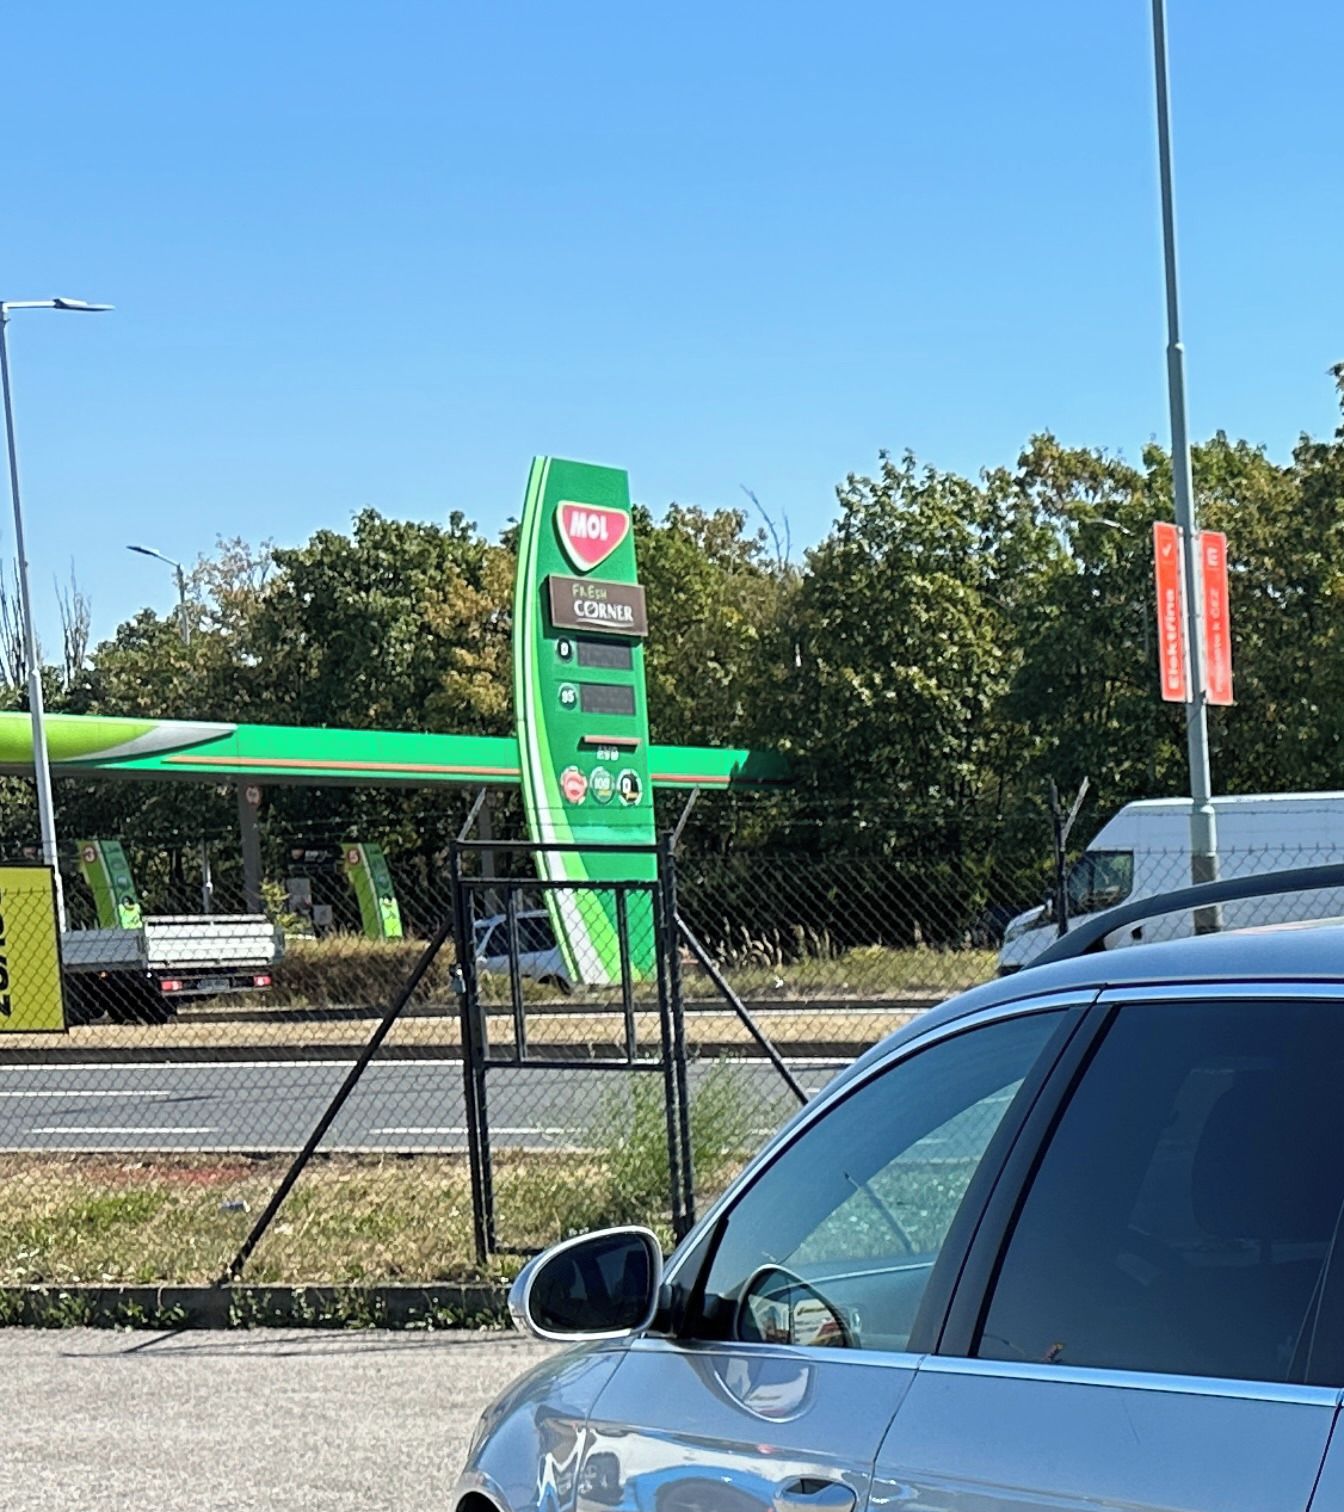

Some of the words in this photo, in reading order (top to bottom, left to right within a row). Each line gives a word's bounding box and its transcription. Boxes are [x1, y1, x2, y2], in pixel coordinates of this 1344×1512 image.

[570, 511, 608, 540] MOL
[572, 584, 607, 599] FRESH
[574, 600, 634, 621] CORNER
